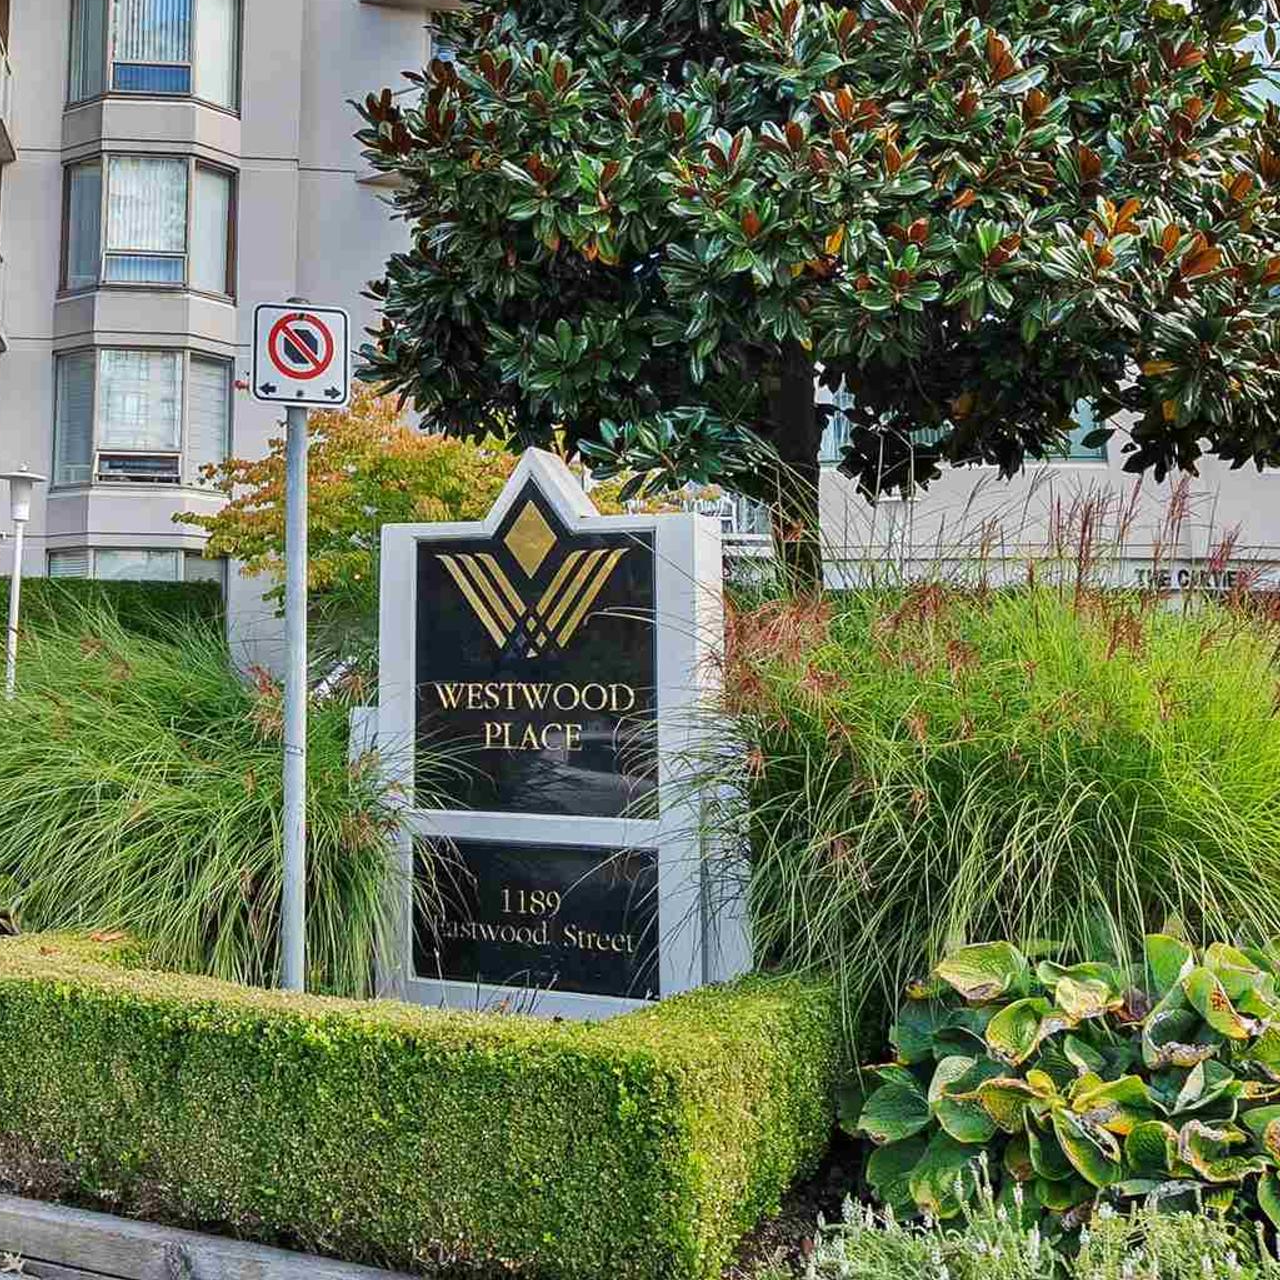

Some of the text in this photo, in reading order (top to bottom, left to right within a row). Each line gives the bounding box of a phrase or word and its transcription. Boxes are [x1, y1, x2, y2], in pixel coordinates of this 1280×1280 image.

[434, 682, 635, 711] WESTWOOD
[482, 722, 584, 751] PLACE
[501, 889, 561, 918] 1189
[564, 924, 634, 952] Street
